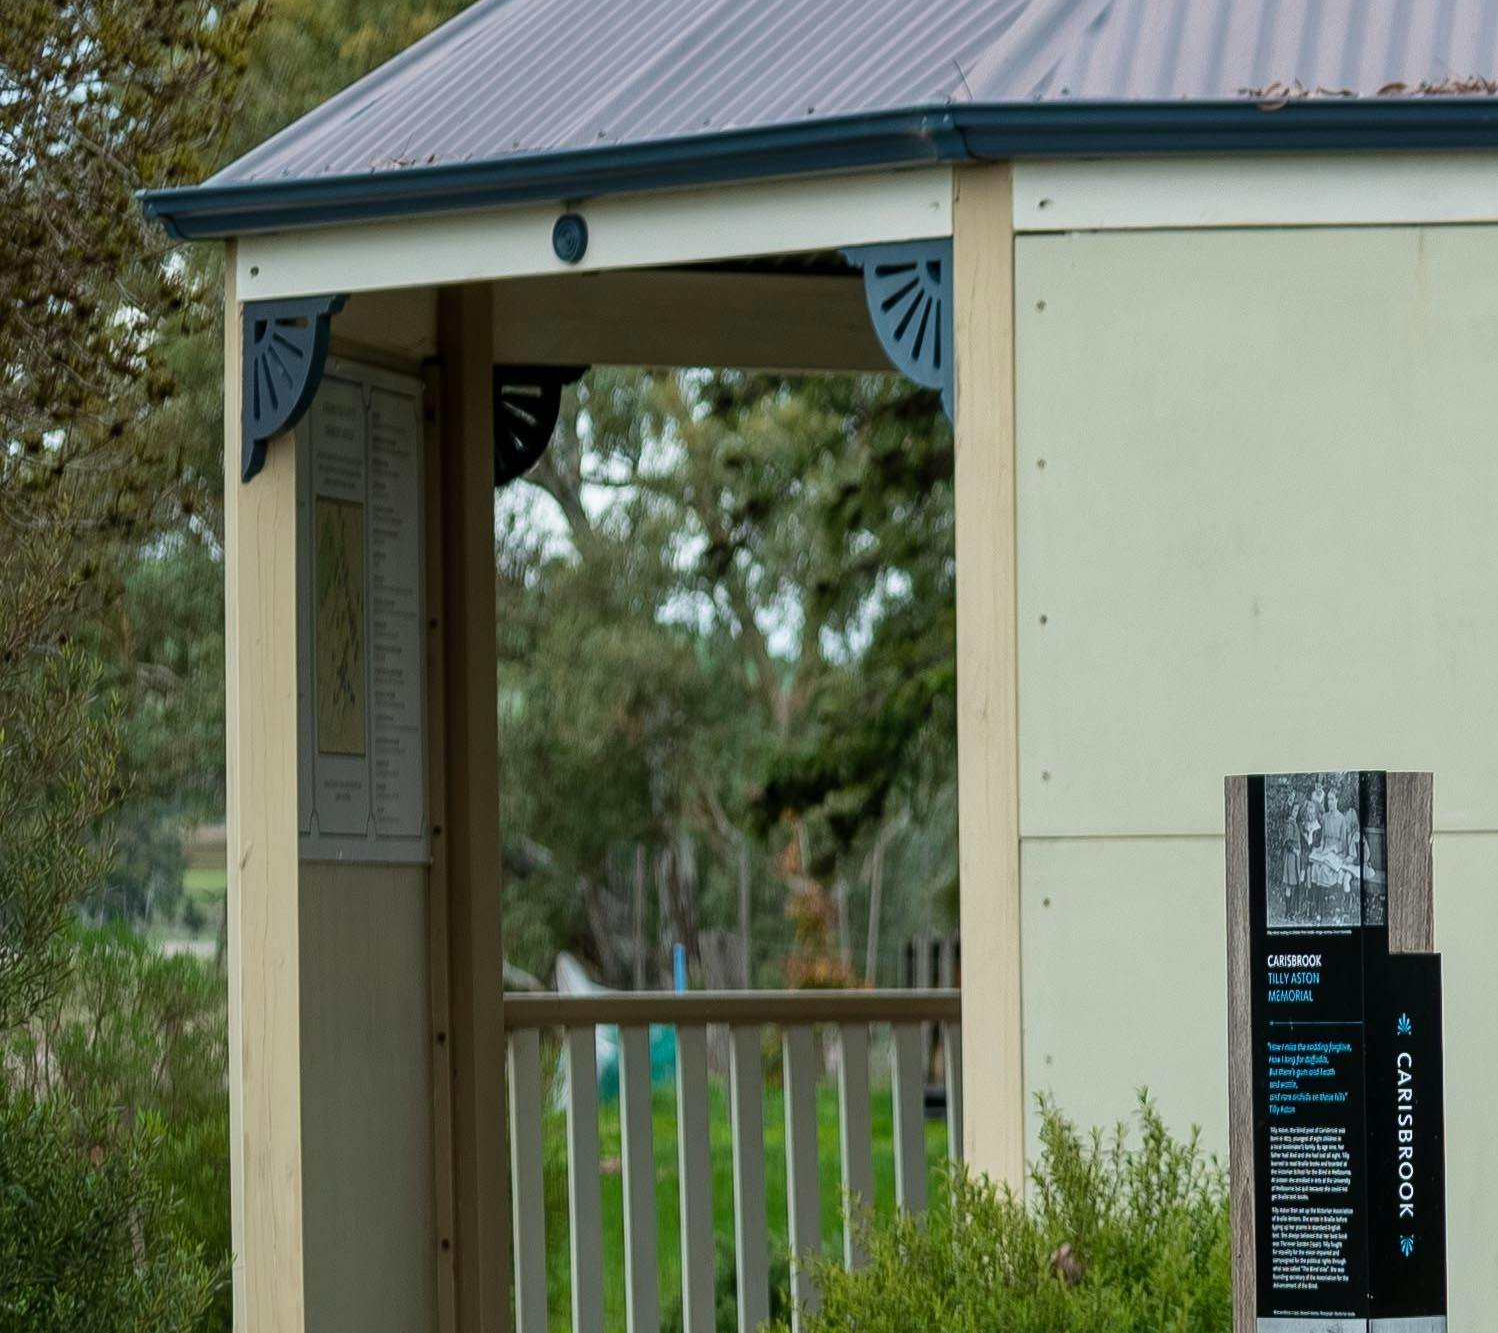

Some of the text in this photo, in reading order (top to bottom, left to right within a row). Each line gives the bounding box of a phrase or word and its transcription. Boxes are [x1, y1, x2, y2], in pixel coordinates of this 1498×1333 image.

[1267, 954, 1322, 967] CARISBROOK
[1268, 972, 1320, 985] TILLY ASTON
[1268, 989, 1314, 1002] MEMORIAL
[1397, 1052, 1414, 1218] CARISBROOK
